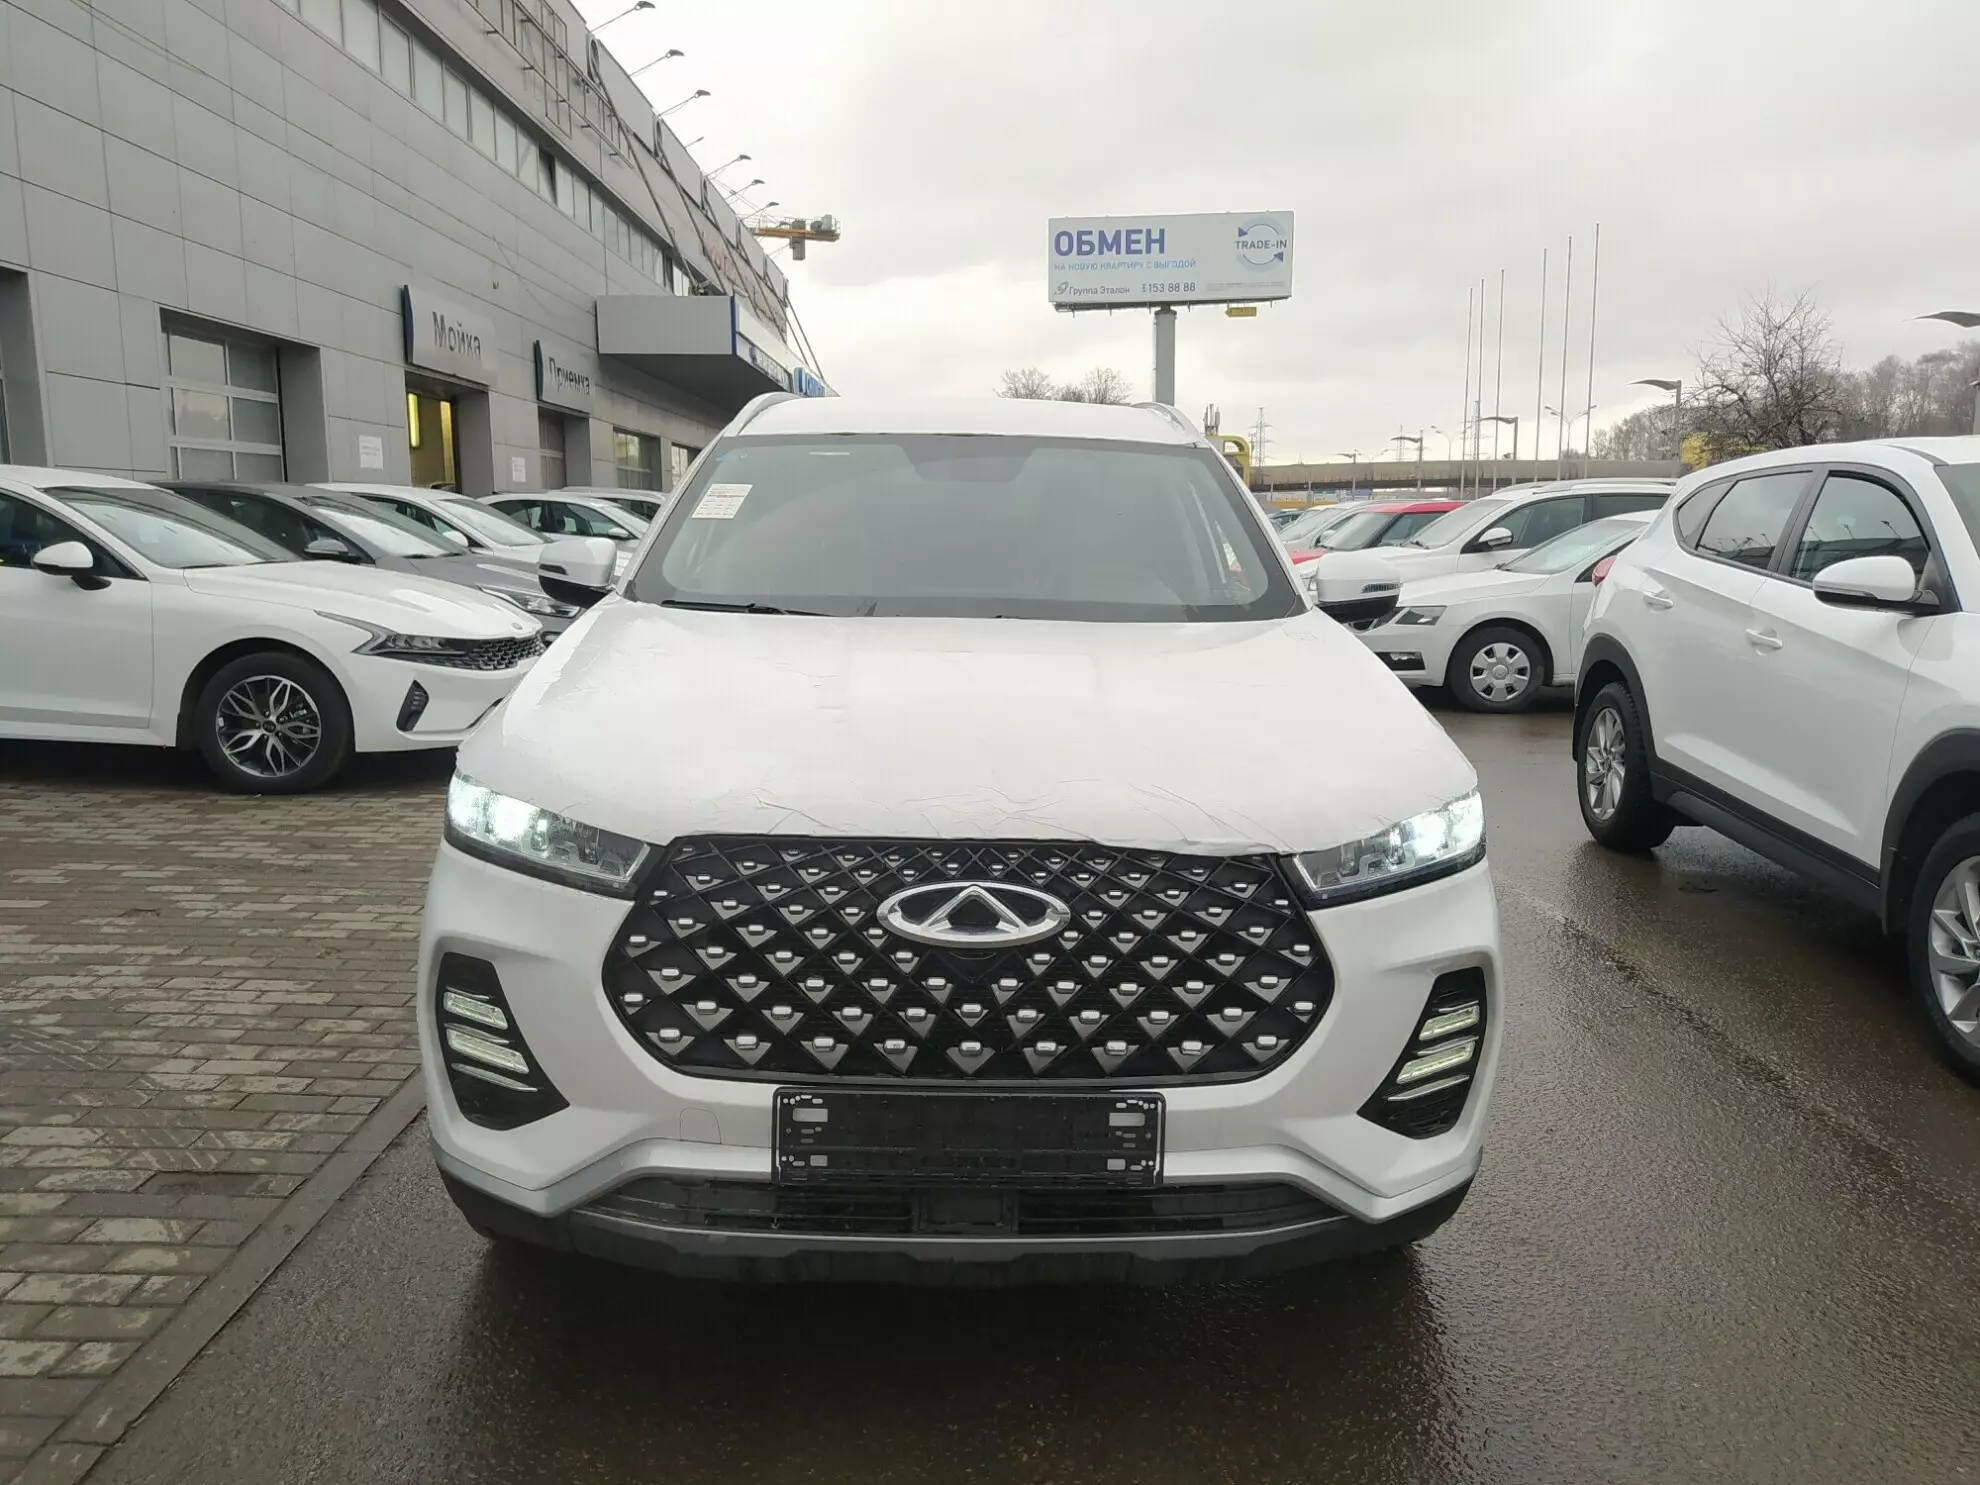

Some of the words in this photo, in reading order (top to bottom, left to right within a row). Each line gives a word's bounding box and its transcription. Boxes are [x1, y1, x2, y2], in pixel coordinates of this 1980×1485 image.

[1054, 228, 1165, 256] ОБМЕН
[1234, 239, 1288, 250] TRADE-IN
[1068, 286, 1098, 296] Группа
[1100, 285, 1131, 295] Эталон
[1148, 283, 1165, 293] 153
[1168, 282, 1181, 293] 88
[1183, 281, 1197, 292] 88
[432, 311, 482, 359] Мойка
[548, 356, 591, 396] Приемка
